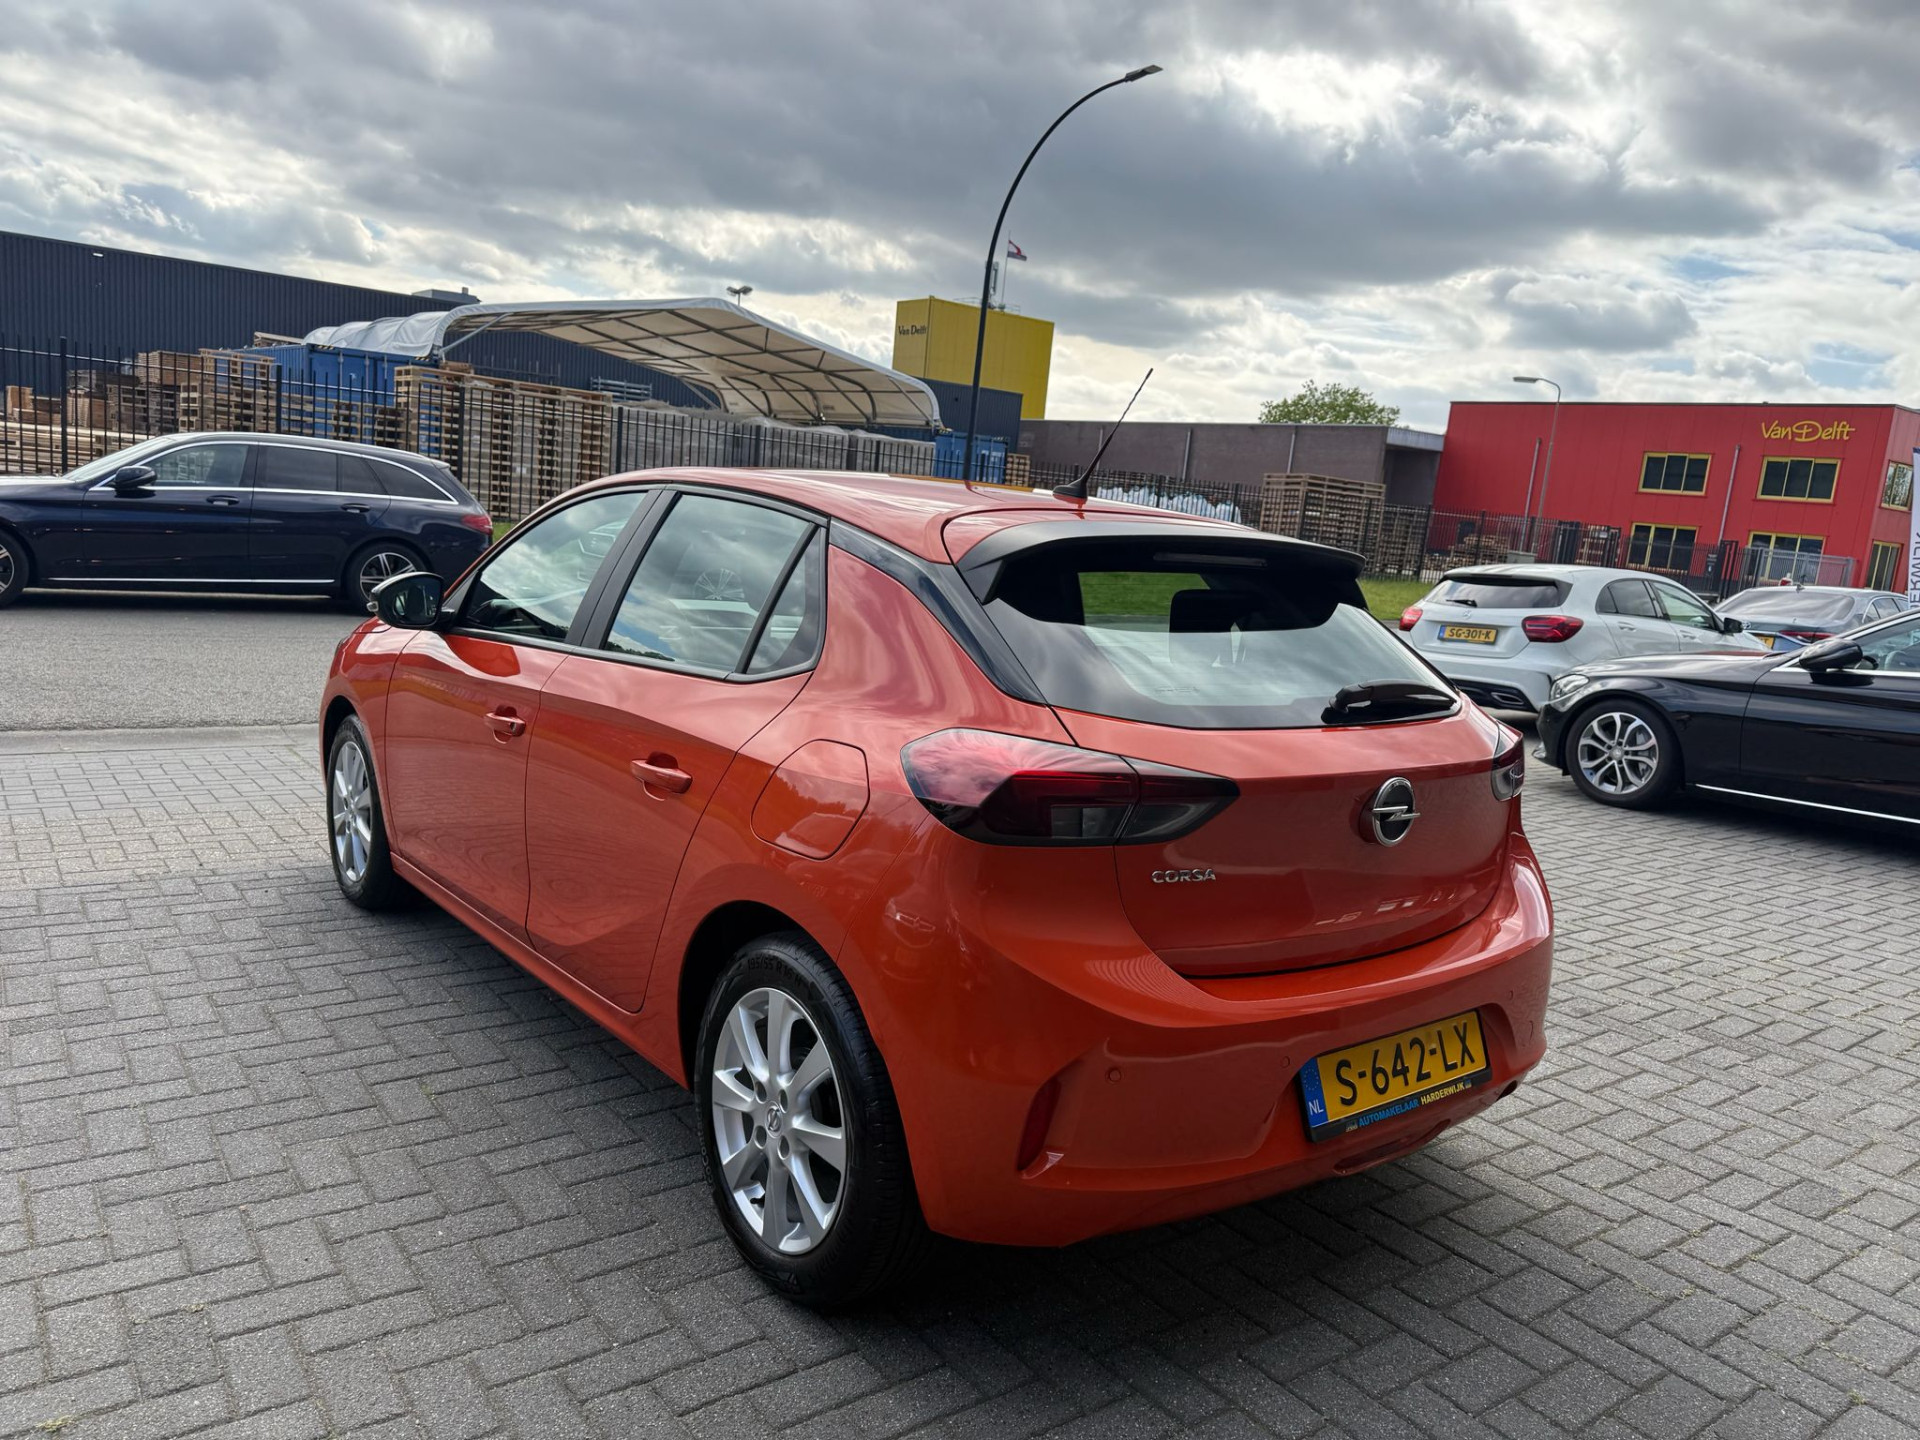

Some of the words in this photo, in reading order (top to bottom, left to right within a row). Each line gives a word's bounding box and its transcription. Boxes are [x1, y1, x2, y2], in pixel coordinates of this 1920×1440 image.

[1448, 628, 1491, 640] SG-301-K
[1151, 868, 1216, 883] CORSA
[1336, 1021, 1475, 1106] S-642-LX
[1308, 1099, 1324, 1116] NL
[1357, 1098, 1420, 1127] AUTOMAKELAAR
[1420, 1081, 1465, 1105] HARDERWIJK
